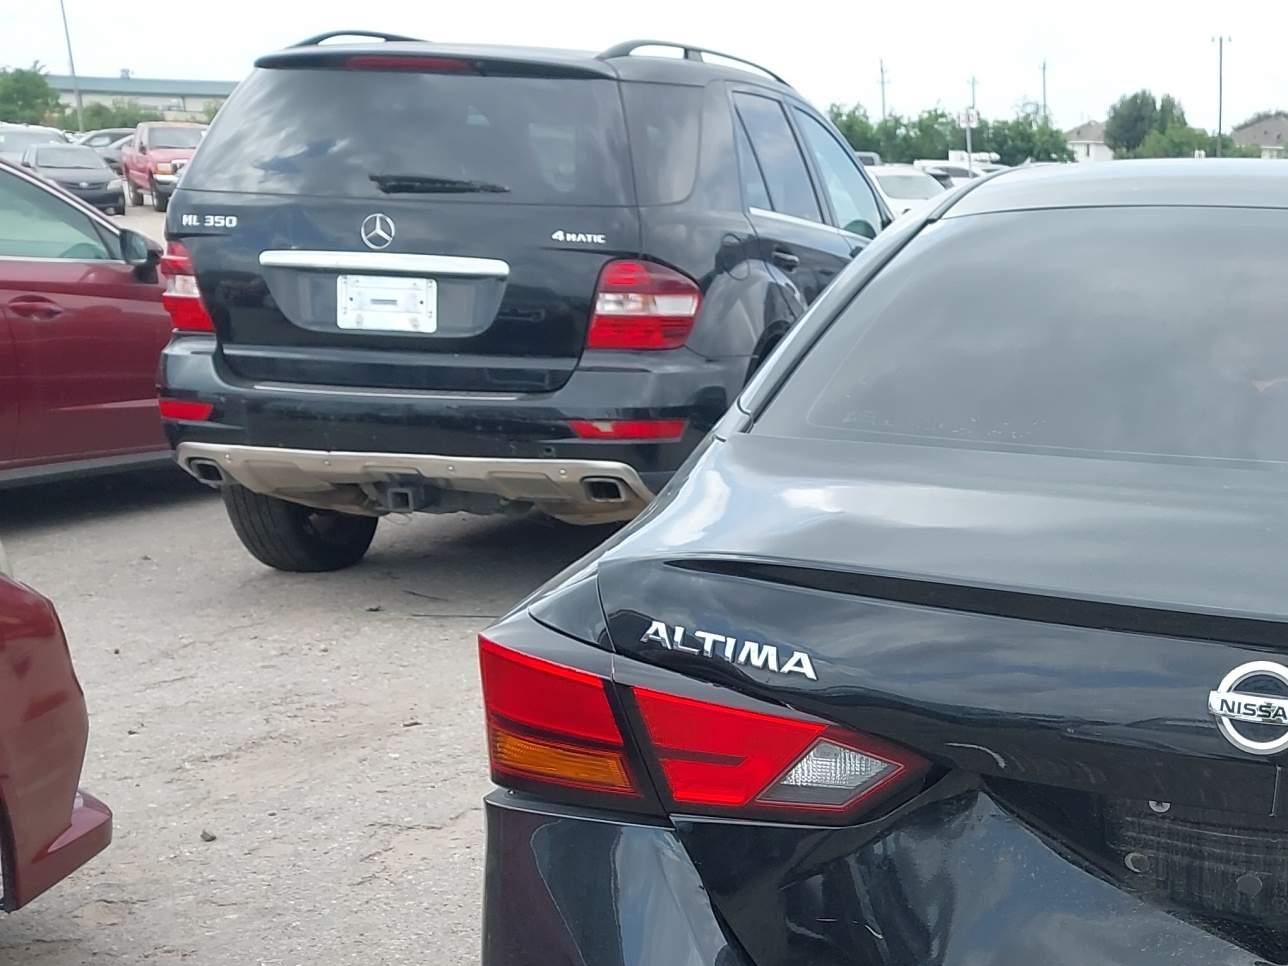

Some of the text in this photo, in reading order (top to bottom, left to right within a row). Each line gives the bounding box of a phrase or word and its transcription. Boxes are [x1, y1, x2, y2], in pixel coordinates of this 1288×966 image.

[183, 214, 238, 228] ML 350
[551, 230, 607, 244] 4MATIC
[640, 620, 818, 681] ALTIMA
